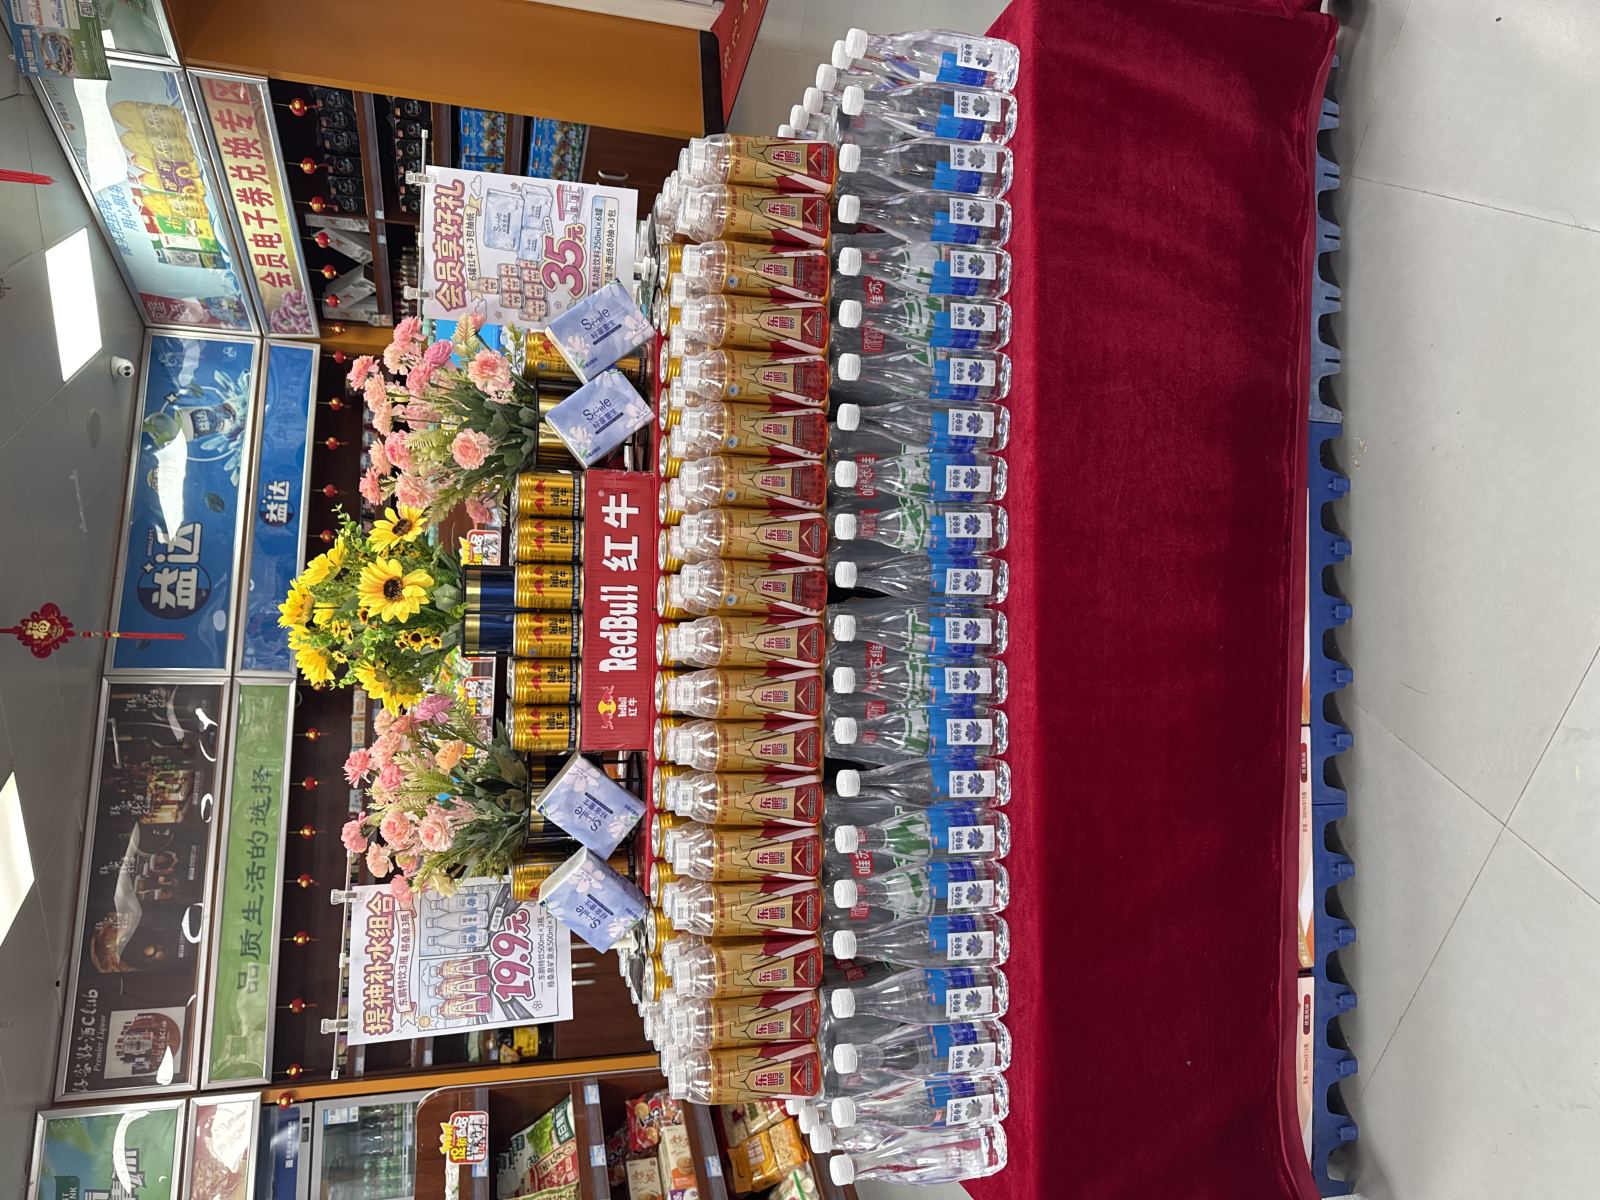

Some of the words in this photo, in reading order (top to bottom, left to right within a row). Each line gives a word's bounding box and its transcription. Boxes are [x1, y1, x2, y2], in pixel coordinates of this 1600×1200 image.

[773, 149, 796, 163] 东鹏
[208, 78, 292, 288] 会员电子券兑换专区
[768, 202, 790, 216] 东鹏
[432, 178, 466, 312] 会员享好礼
[542, 224, 584, 298] 35元
[763, 264, 784, 276] 东鹏
[580, 308, 611, 331] Smile
[767, 316, 790, 328] 东鹏
[763, 370, 783, 382] 东鹏
[582, 398, 612, 422] Smile
[762, 423, 782, 434] 东鹏
[761, 476, 780, 487] 东鹏
[266, 480, 290, 523] 益达
[601, 493, 640, 572] 红牛
[765, 529, 788, 542] 东鹏
[152, 522, 202, 610] 益达
[762, 580, 782, 592] 东鹏
[22, 619, 51, 639] 福
[598, 584, 638, 672] RedBull
[764, 638, 786, 649] 东鹏
[761, 690, 783, 702] 东鹏
[618, 696, 628, 718] RedBull
[628, 697, 638, 717] 红牛
[760, 744, 783, 756] 东鹏
[760, 797, 782, 810] 东鹏
[574, 806, 602, 832] Smile
[757, 852, 780, 864] 东鹏
[236, 764, 272, 995] 品质生活的选择
[574, 905, 600, 930] Smile
[757, 908, 780, 920] 东鹏
[401, 913, 410, 952] 格桑泉3瓶
[363, 890, 394, 1036] 提神补水组合
[492, 911, 533, 1001] 19.9元
[398, 955, 410, 1006] 东鹏特饮3瓶
[759, 969, 782, 982] 东鹏
[96, 1014, 108, 1040] Liquor
[756, 1022, 778, 1036] 东鹏
[93, 1042, 104, 1072] Premier
[756, 1072, 778, 1087] 东鹏
